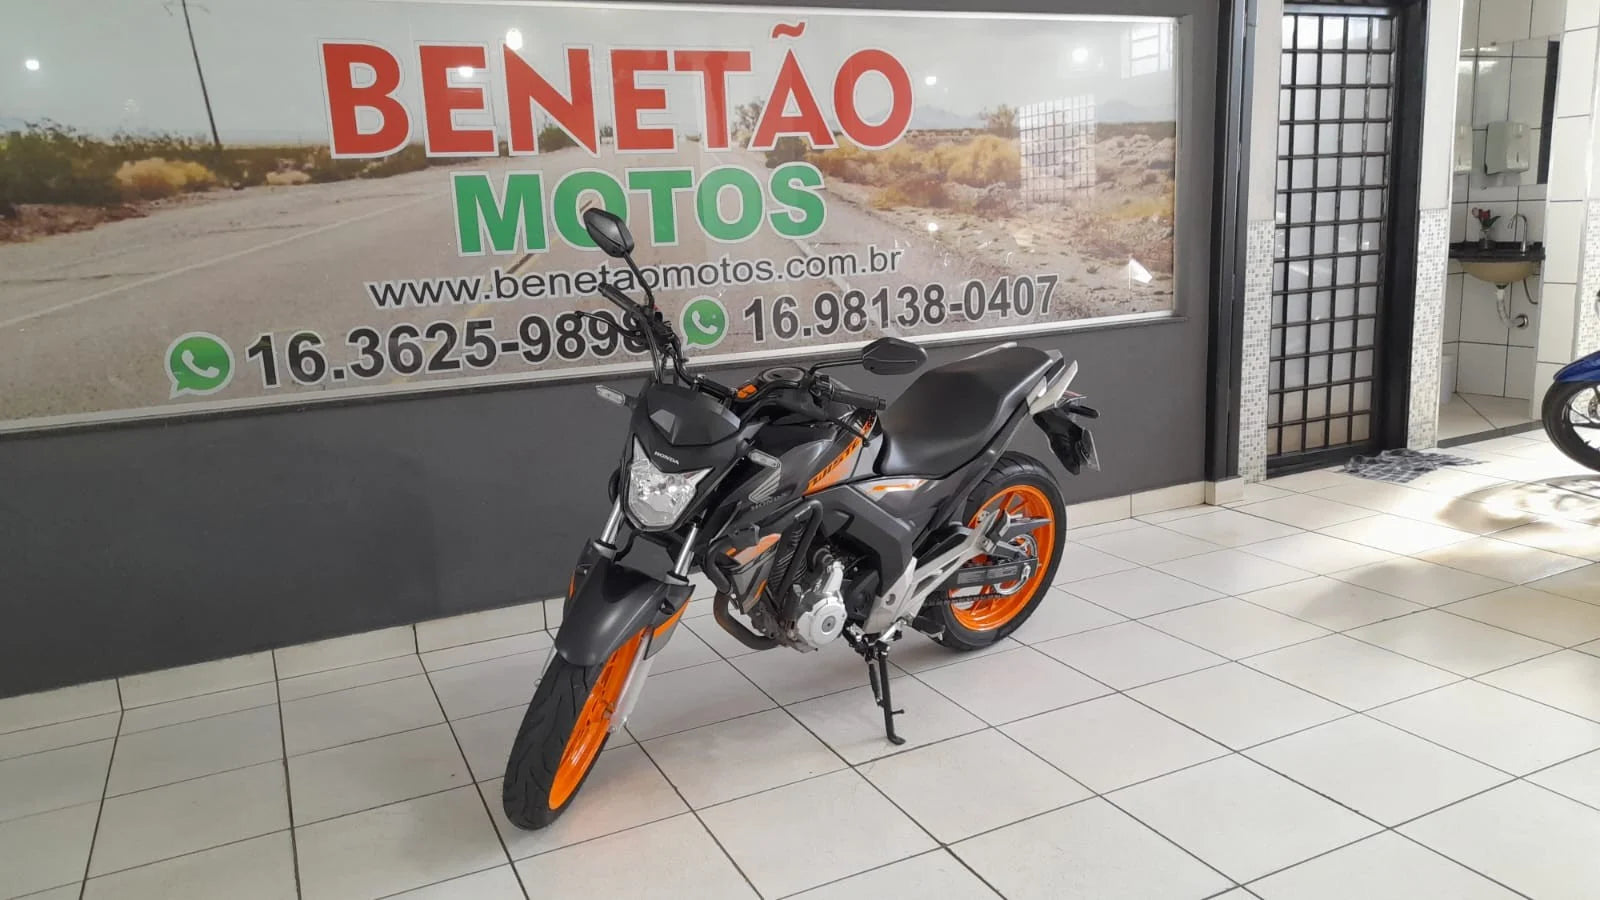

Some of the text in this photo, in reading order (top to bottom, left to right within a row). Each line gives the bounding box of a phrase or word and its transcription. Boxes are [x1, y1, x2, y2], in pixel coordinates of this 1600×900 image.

[321, 21, 914, 155] BENETÃO
[452, 165, 826, 254] MOTOS
[368, 248, 902, 307] www.benetaomotos.com.br
[743, 274, 1059, 342] 16.98138-0407
[653, 450, 680, 465] HONDA
